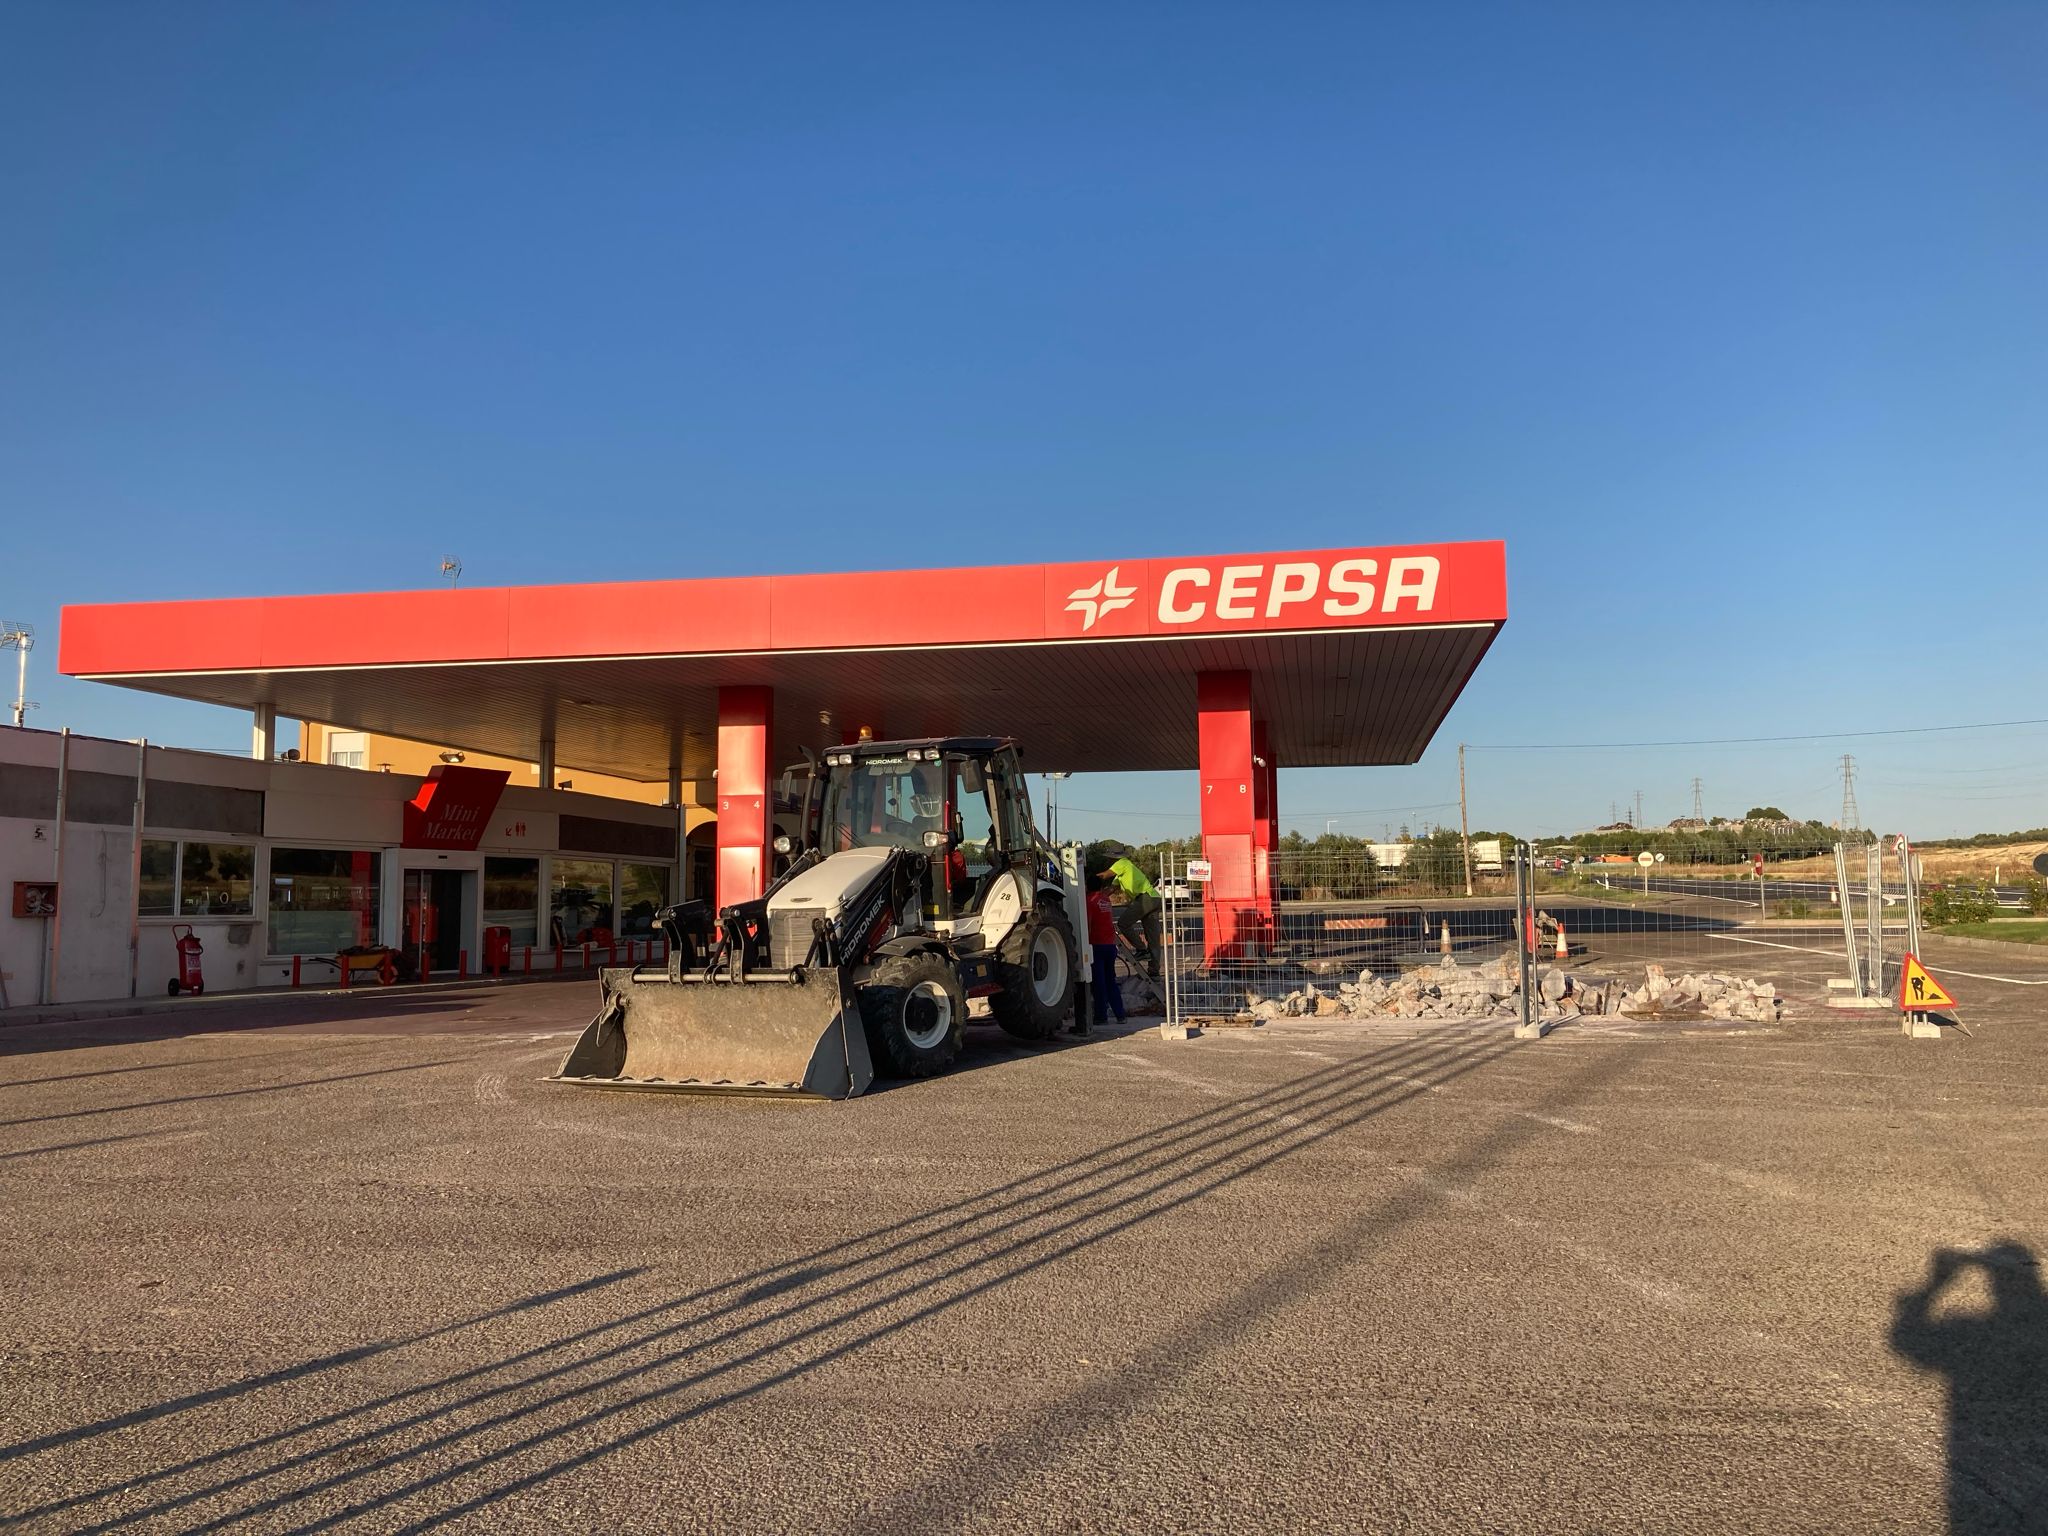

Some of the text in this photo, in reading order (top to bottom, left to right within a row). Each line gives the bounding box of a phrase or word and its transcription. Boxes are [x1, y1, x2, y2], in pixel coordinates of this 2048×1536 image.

[1157, 556, 1441, 624] CEPSA
[1206, 785, 1213, 794] 7
[1239, 784, 1247, 794] 8
[722, 801, 729, 810] 3
[753, 800, 760, 809] 4
[440, 803, 480, 821] Mini
[422, 822, 478, 841] Market
[1000, 892, 1012, 901] 28
